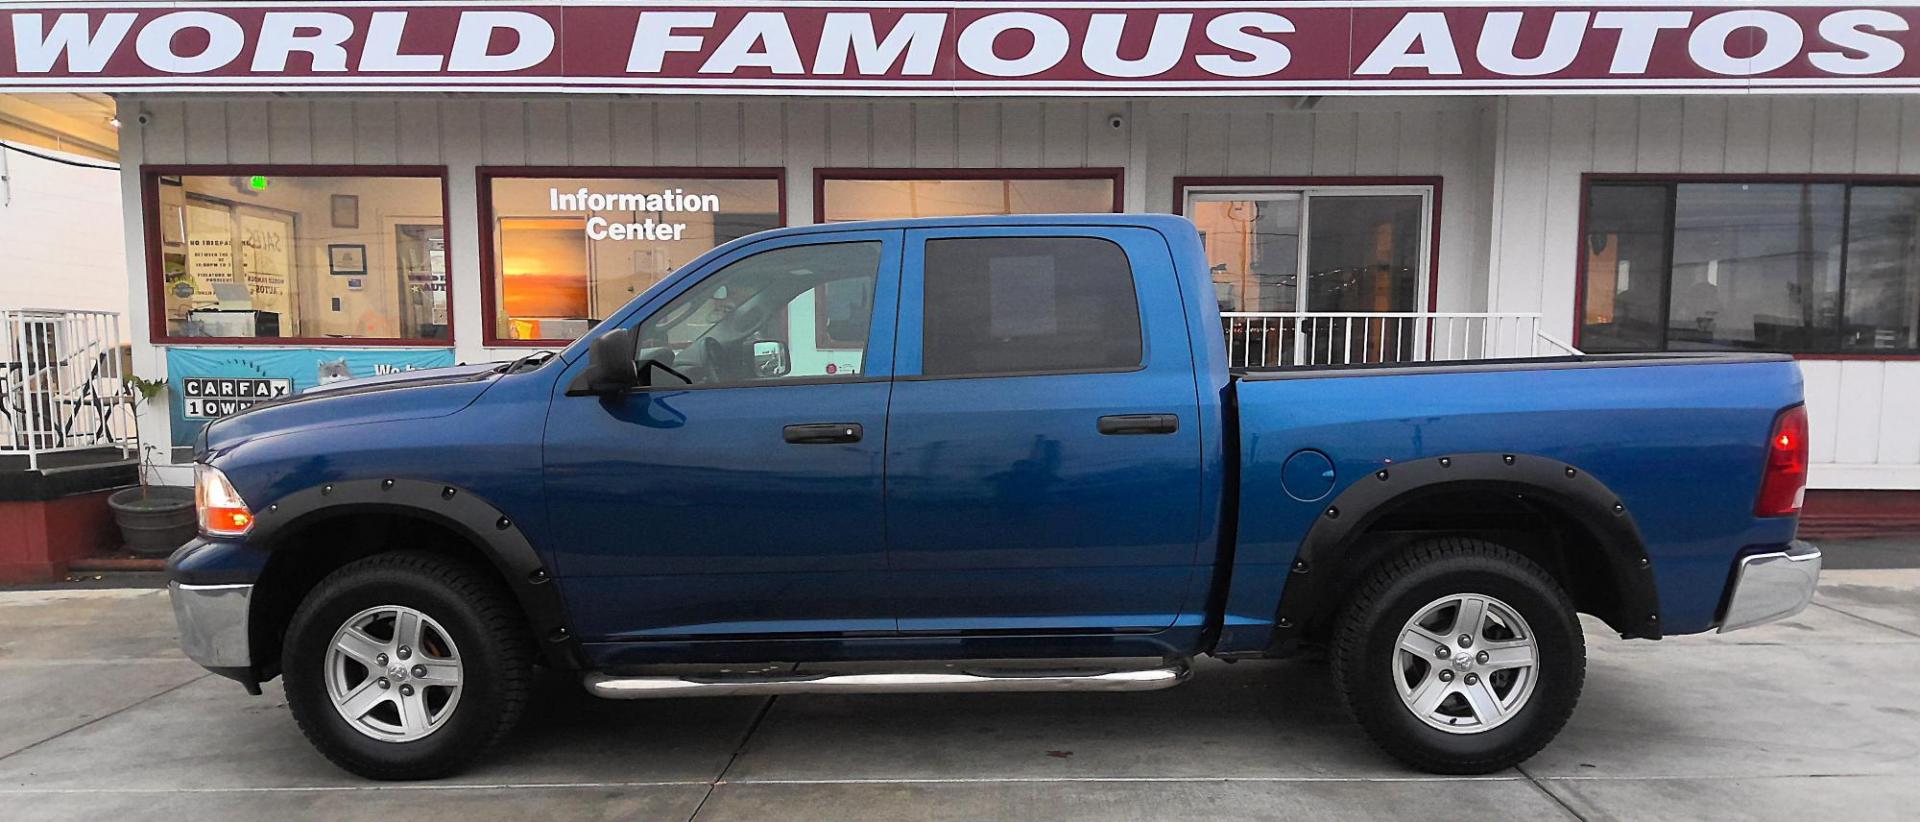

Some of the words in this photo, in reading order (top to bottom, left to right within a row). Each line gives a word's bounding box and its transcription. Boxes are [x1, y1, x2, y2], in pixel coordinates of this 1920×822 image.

[11, 11, 555, 72] WORLD
[626, 12, 1293, 76] FAMOUS
[1353, 10, 1909, 74] AUTOS
[550, 187, 719, 212] Information
[586, 217, 686, 241] Center
[187, 381, 286, 398] CARFAX
